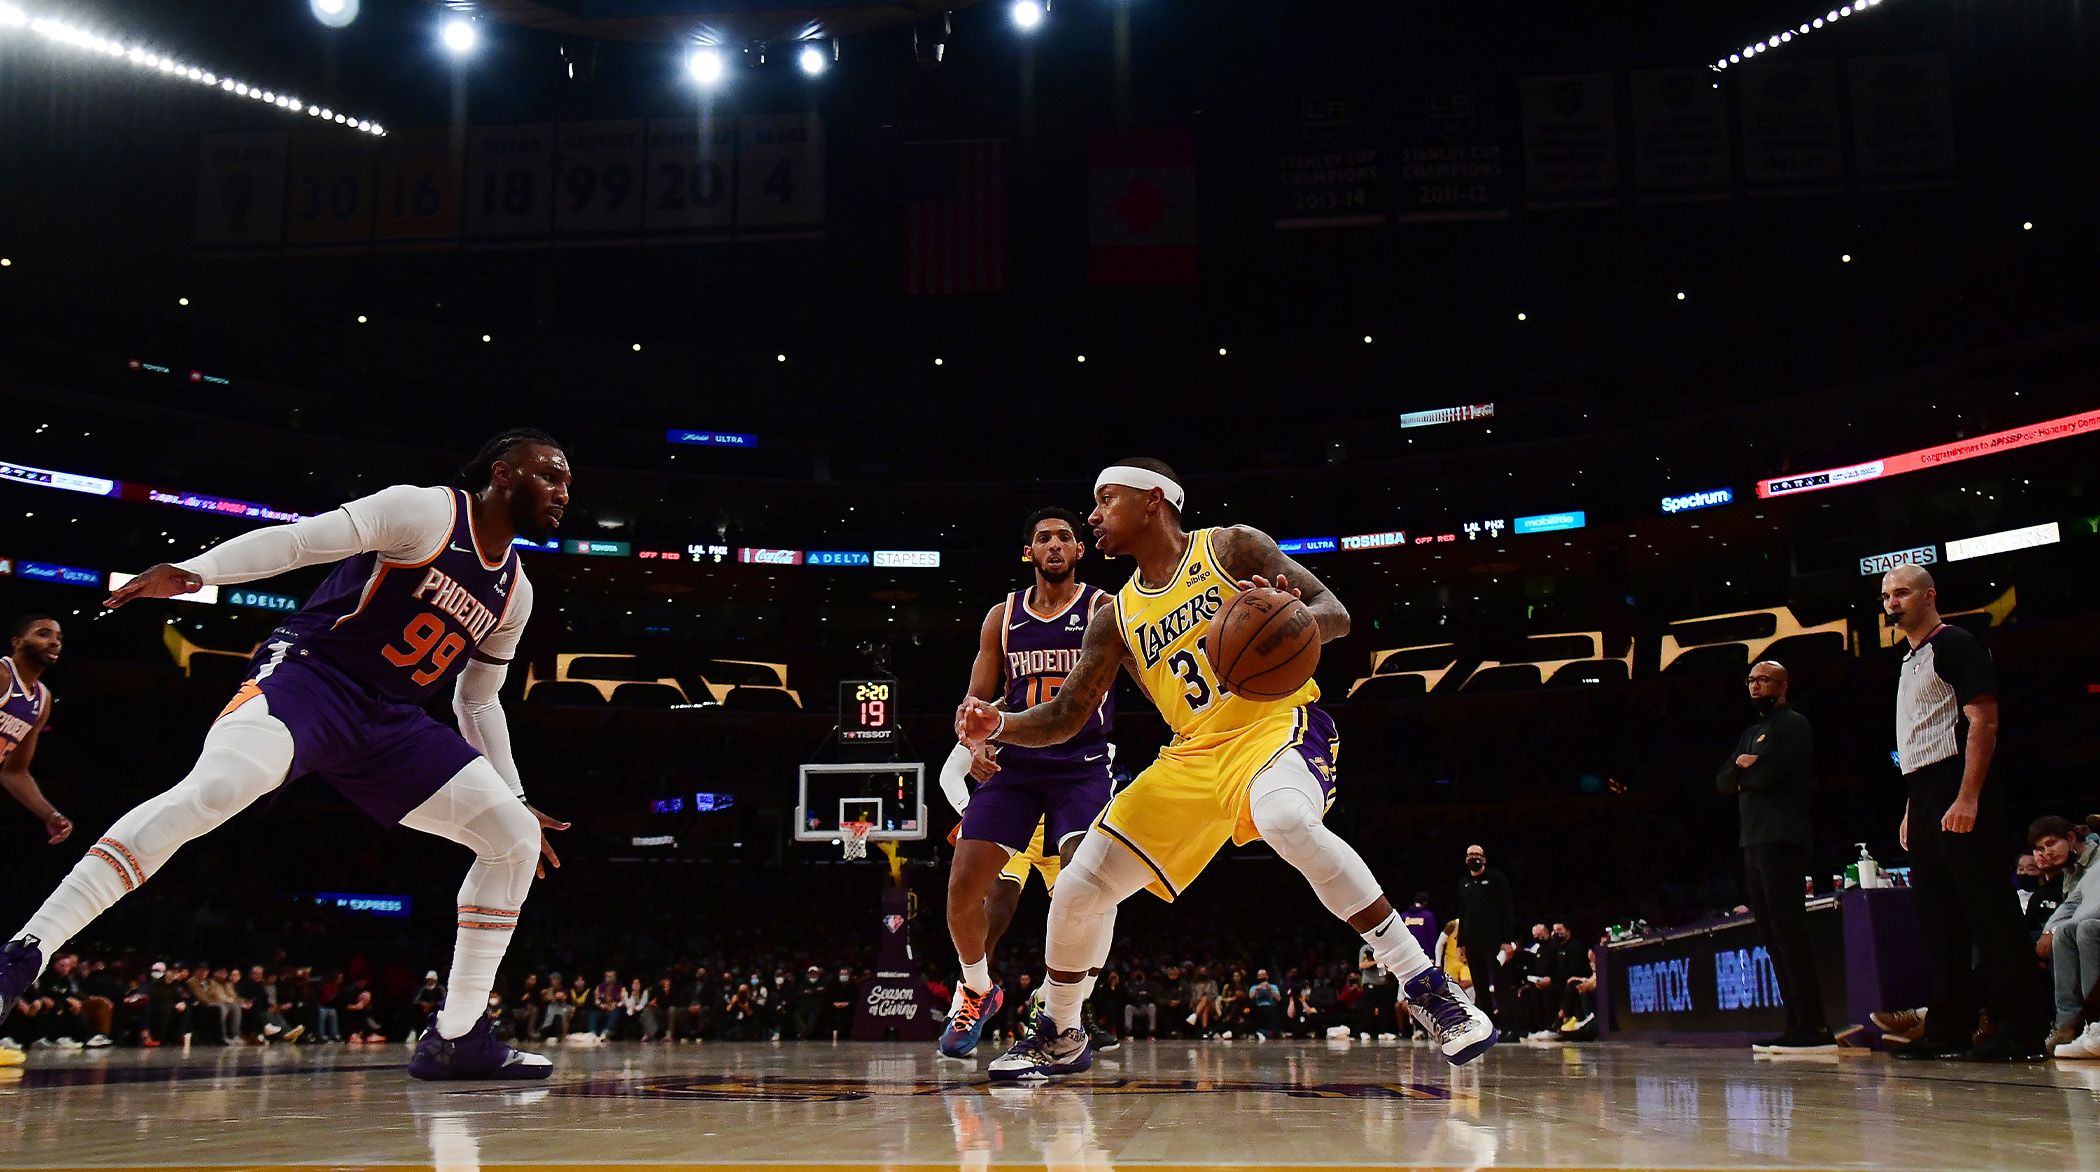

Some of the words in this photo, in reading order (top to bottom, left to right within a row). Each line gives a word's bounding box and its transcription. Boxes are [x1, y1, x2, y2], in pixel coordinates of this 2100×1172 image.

[1347, 150, 1377, 165] CUP
[1402, 146, 1465, 162] STANLEY
[1470, 145, 1501, 160] CUP
[1280, 165, 1377, 185] CHAMPIONS
[1402, 161, 1502, 180] CHAMPIONS
[482, 168, 534, 216] 18
[566, 163, 634, 211] 99
[657, 162, 723, 208] 20
[763, 159, 794, 205] 4
[394, 171, 442, 218] 16
[1294, 188, 1367, 210] 2013-14
[1417, 184, 1490, 205] 2011-12
[715, 435, 744, 444] ULTRA
[1661, 490, 1728, 513] Spectrum
[1307, 540, 1335, 550] ULTRA
[1341, 532, 1405, 550] TOSHIBA
[1415, 536, 1433, 545] OFF
[639, 551, 658, 559] OFF
[823, 553, 870, 565] DELTA
[876, 552, 937, 566] STAPLES
[1186, 570, 1211, 588] bibigo
[246, 592, 297, 611] DELTA
[411, 565, 499, 646] PHOENIX
[1134, 584, 1224, 671] LAKERS
[381, 611, 467, 687] 99
[1008, 648, 1083, 679] PHOENI
[856, 684, 889, 701] 2:20
[861, 700, 884, 727] 19
[867, 985, 914, 1005] Season
[879, 1000, 918, 1020] Giving
